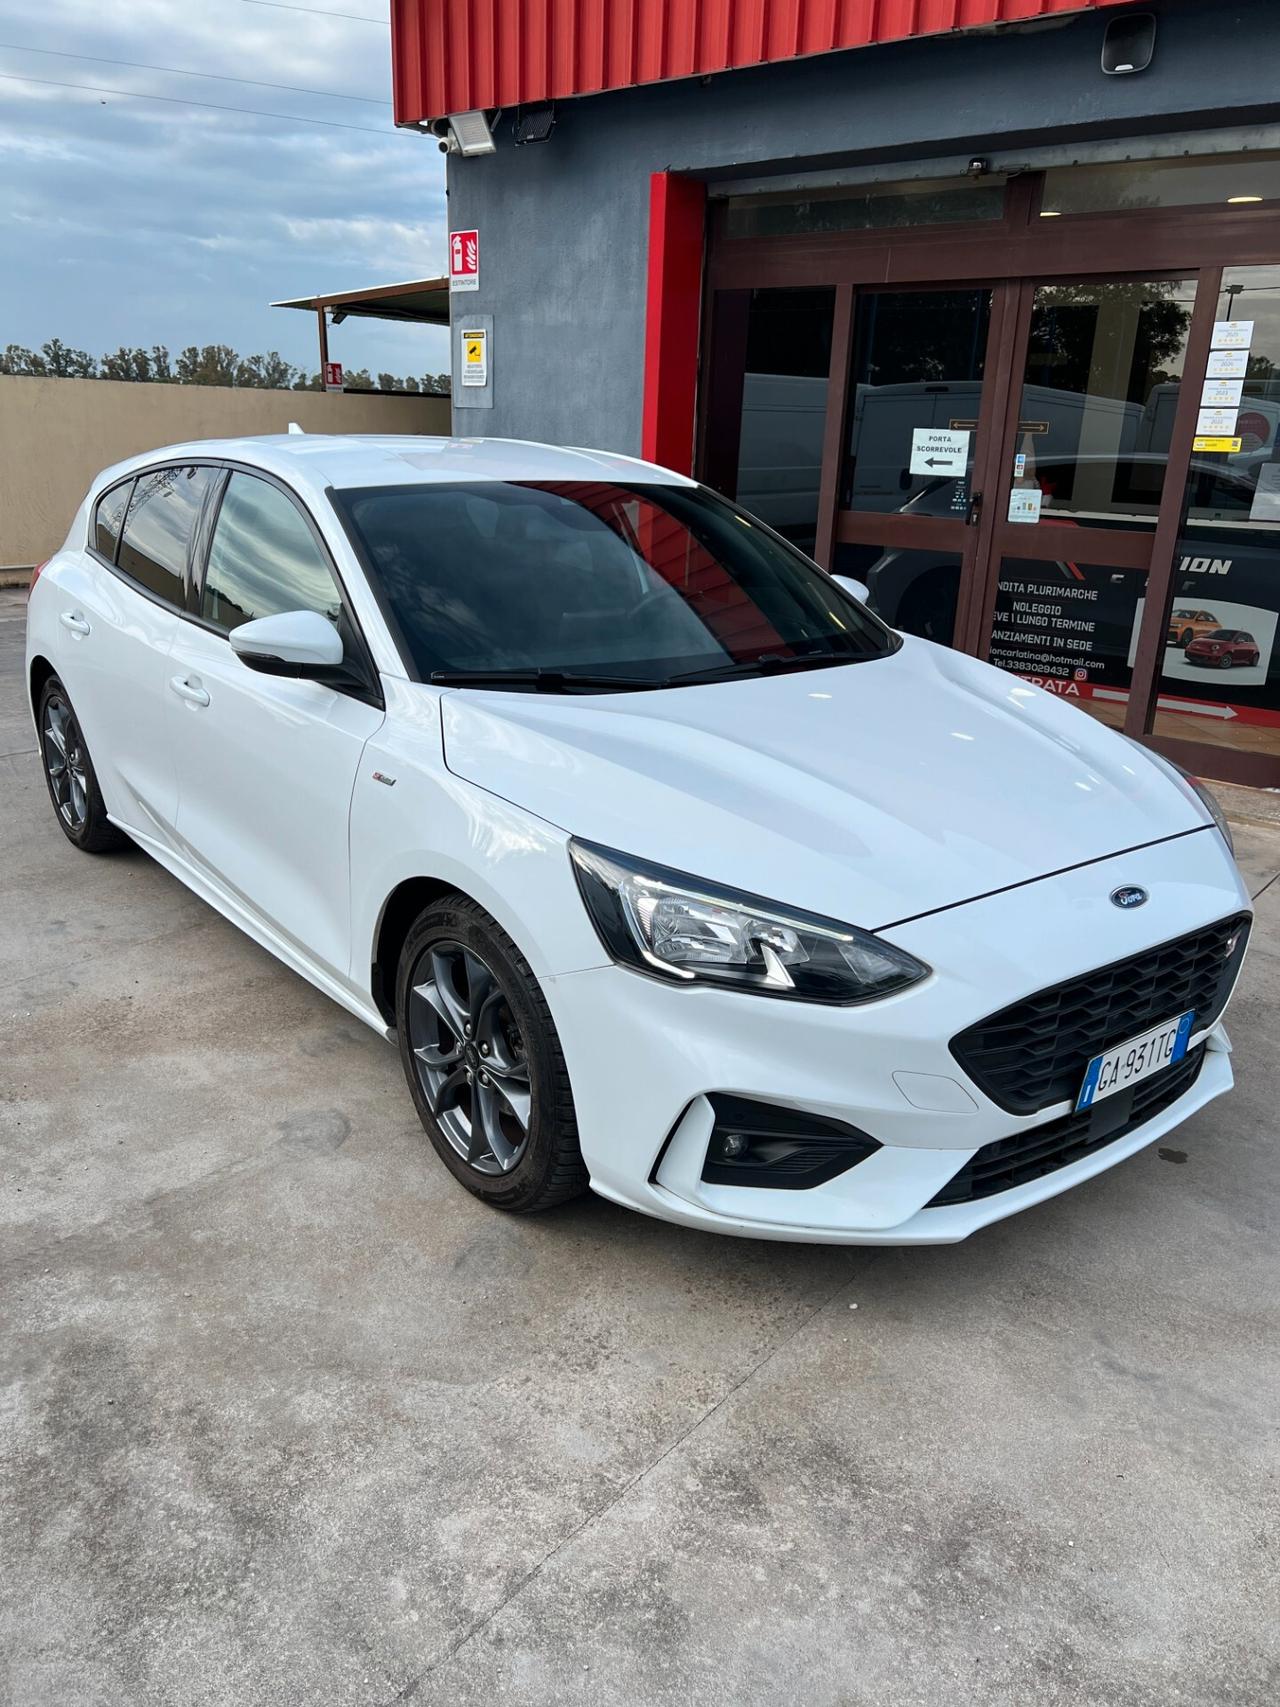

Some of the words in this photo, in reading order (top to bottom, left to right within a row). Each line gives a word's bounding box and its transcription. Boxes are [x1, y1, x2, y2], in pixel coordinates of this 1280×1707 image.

[928, 435, 952, 443] PORTA
[916, 445, 963, 454] SCORREVOLE
[1180, 556, 1233, 575] ION
[1027, 584, 1098, 601] PLURIMARCHE
[1013, 601, 1062, 616] NOLEGGIO
[1017, 614, 1048, 626] LUNGO
[1051, 617, 1096, 632] TERMINE
[991, 629, 1050, 646] ANZIAMENTI
[1053, 637, 1065, 648] IN
[1066, 638, 1093, 651] SEDE
[1119, 892, 1143, 905] Ford
